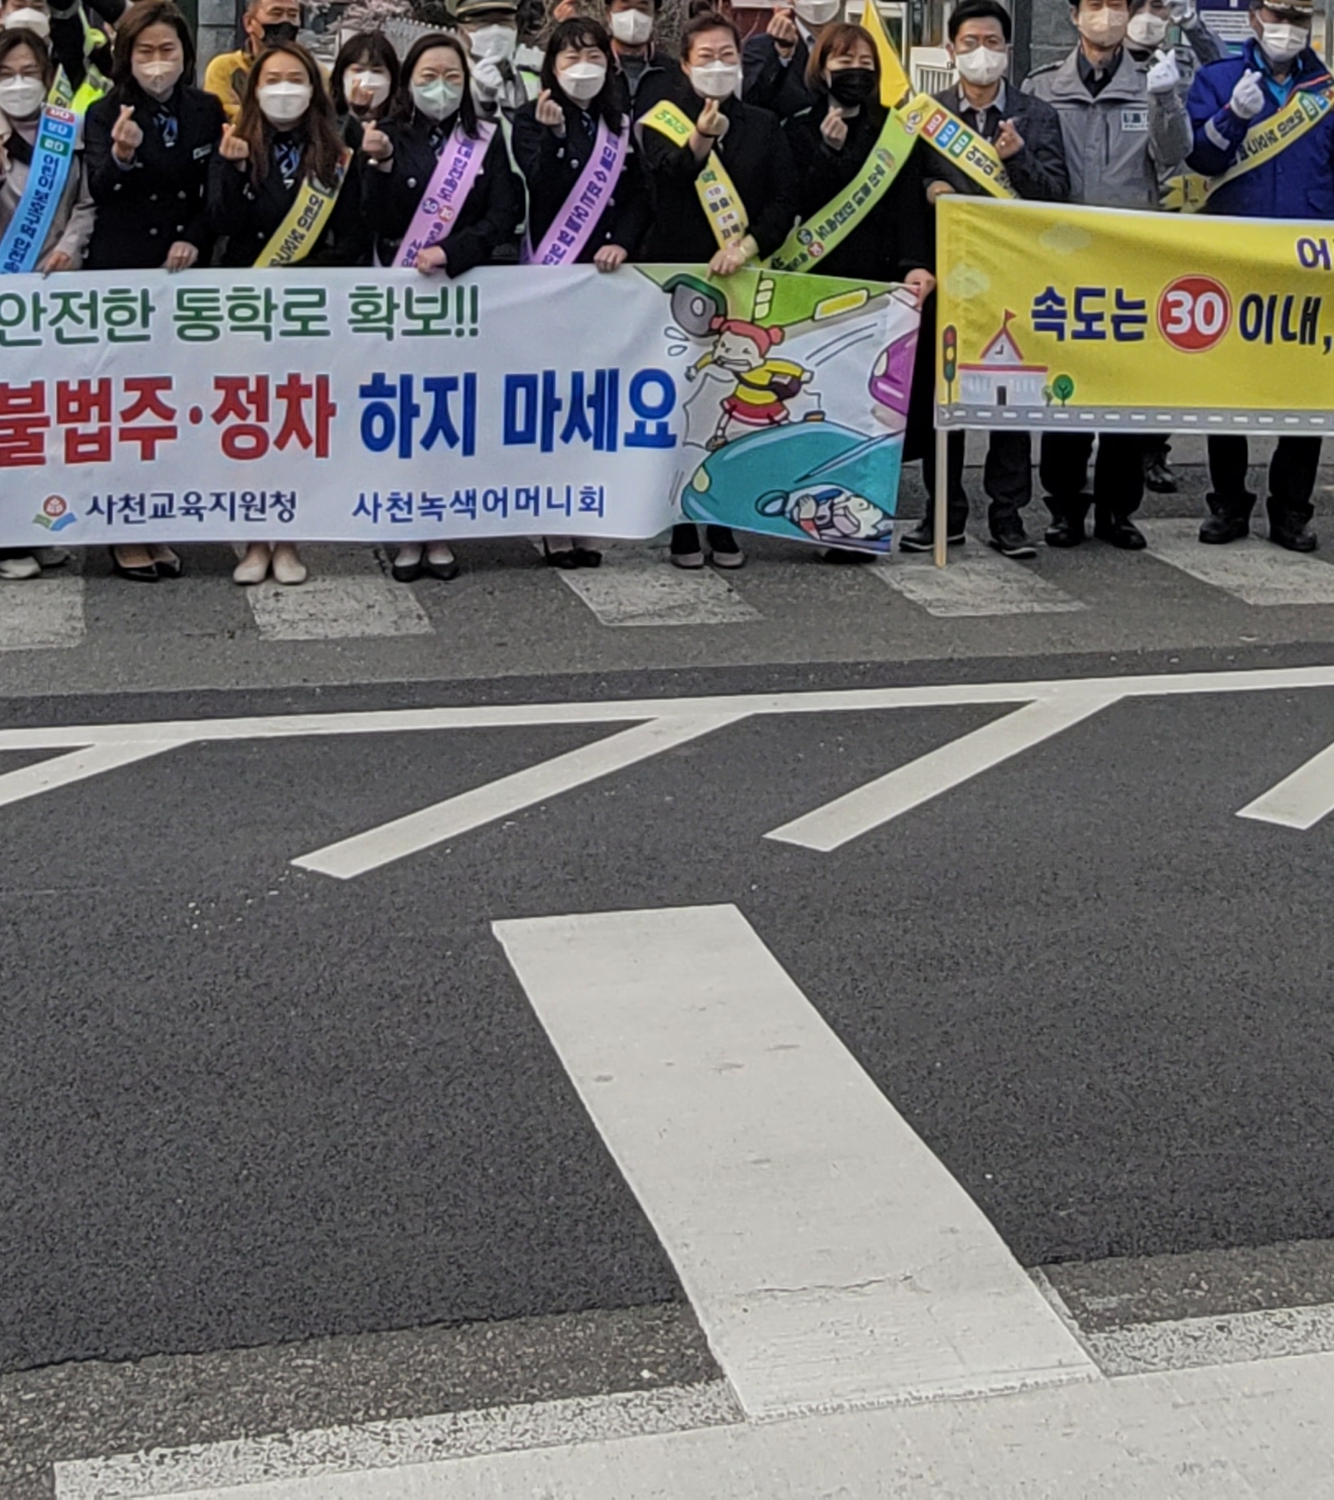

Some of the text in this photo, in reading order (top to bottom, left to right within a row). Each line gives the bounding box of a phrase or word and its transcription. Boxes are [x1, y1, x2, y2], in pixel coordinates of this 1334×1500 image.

[173, 286, 331, 342] 통학로
[348, 284, 479, 341] 확보!!
[1030, 285, 1147, 342] 속도는
[1167, 291, 1223, 335] 30
[1240, 294, 1331, 354] 이내,
[359, 373, 476, 459] 하지
[503, 369, 677, 453] 마세요
[87, 492, 295, 524] 사천교육지원청
[354, 487, 603, 522] 사천녹색어머니회
